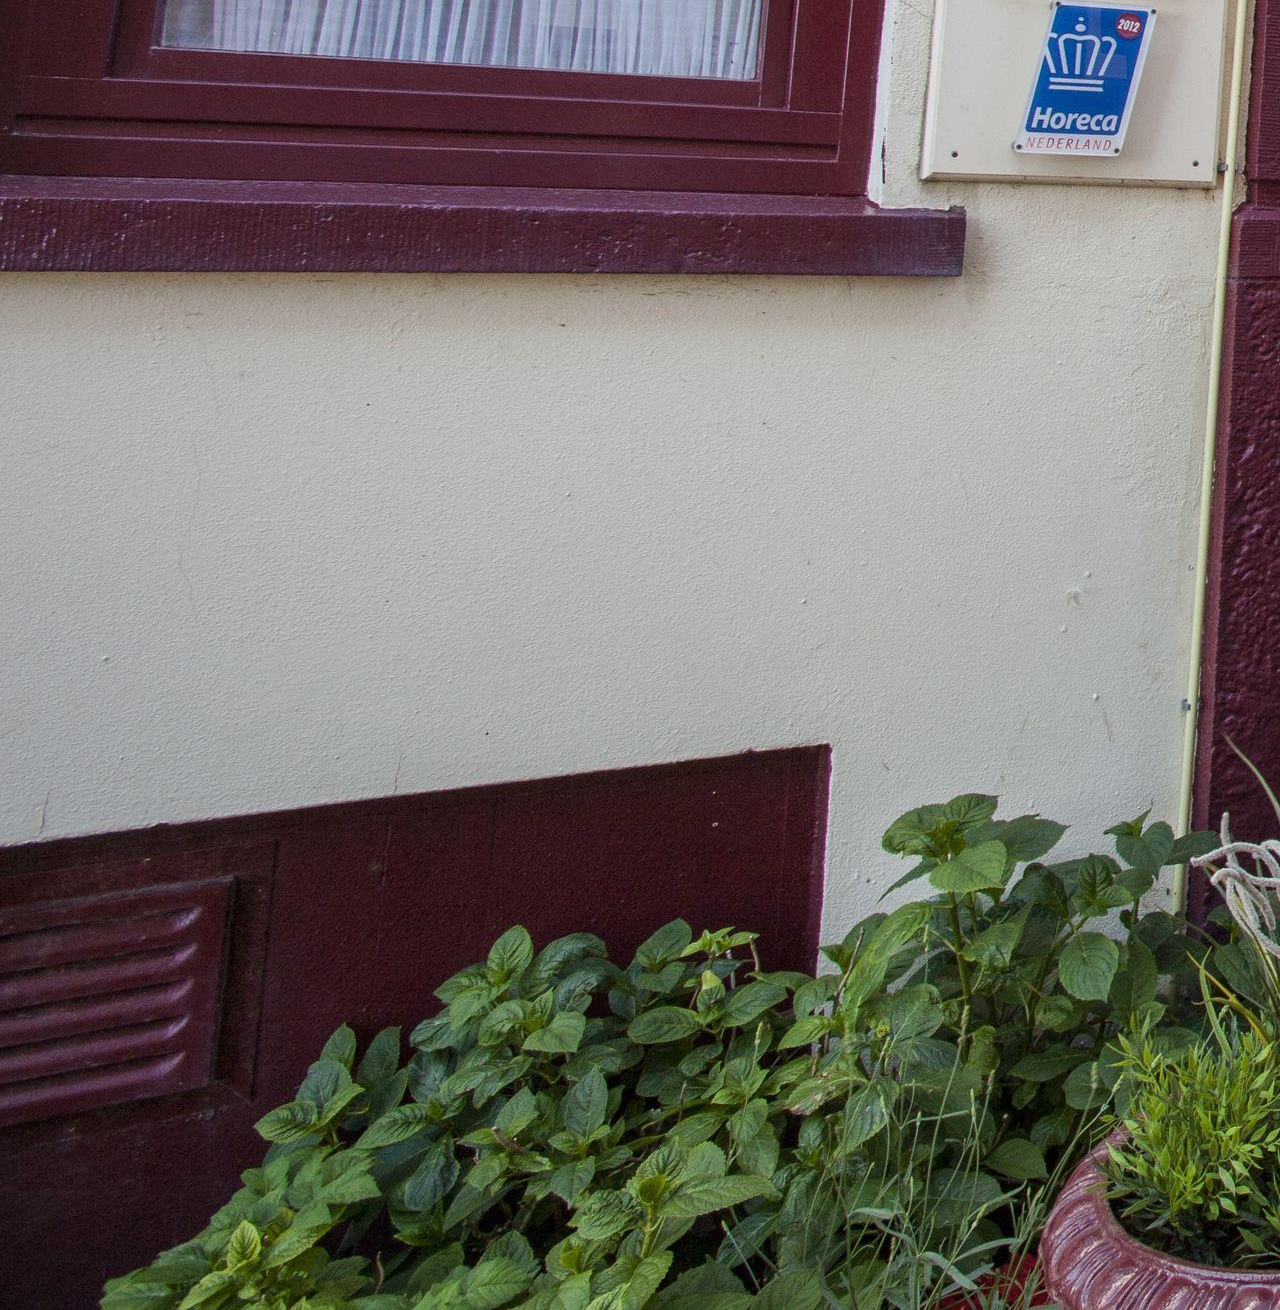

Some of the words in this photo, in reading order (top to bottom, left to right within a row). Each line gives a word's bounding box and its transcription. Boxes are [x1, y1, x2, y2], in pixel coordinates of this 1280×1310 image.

[1117, 18, 1141, 33] 2012
[1031, 106, 1118, 132] Horeca
[1025, 136, 1112, 151] NEDERLAND
